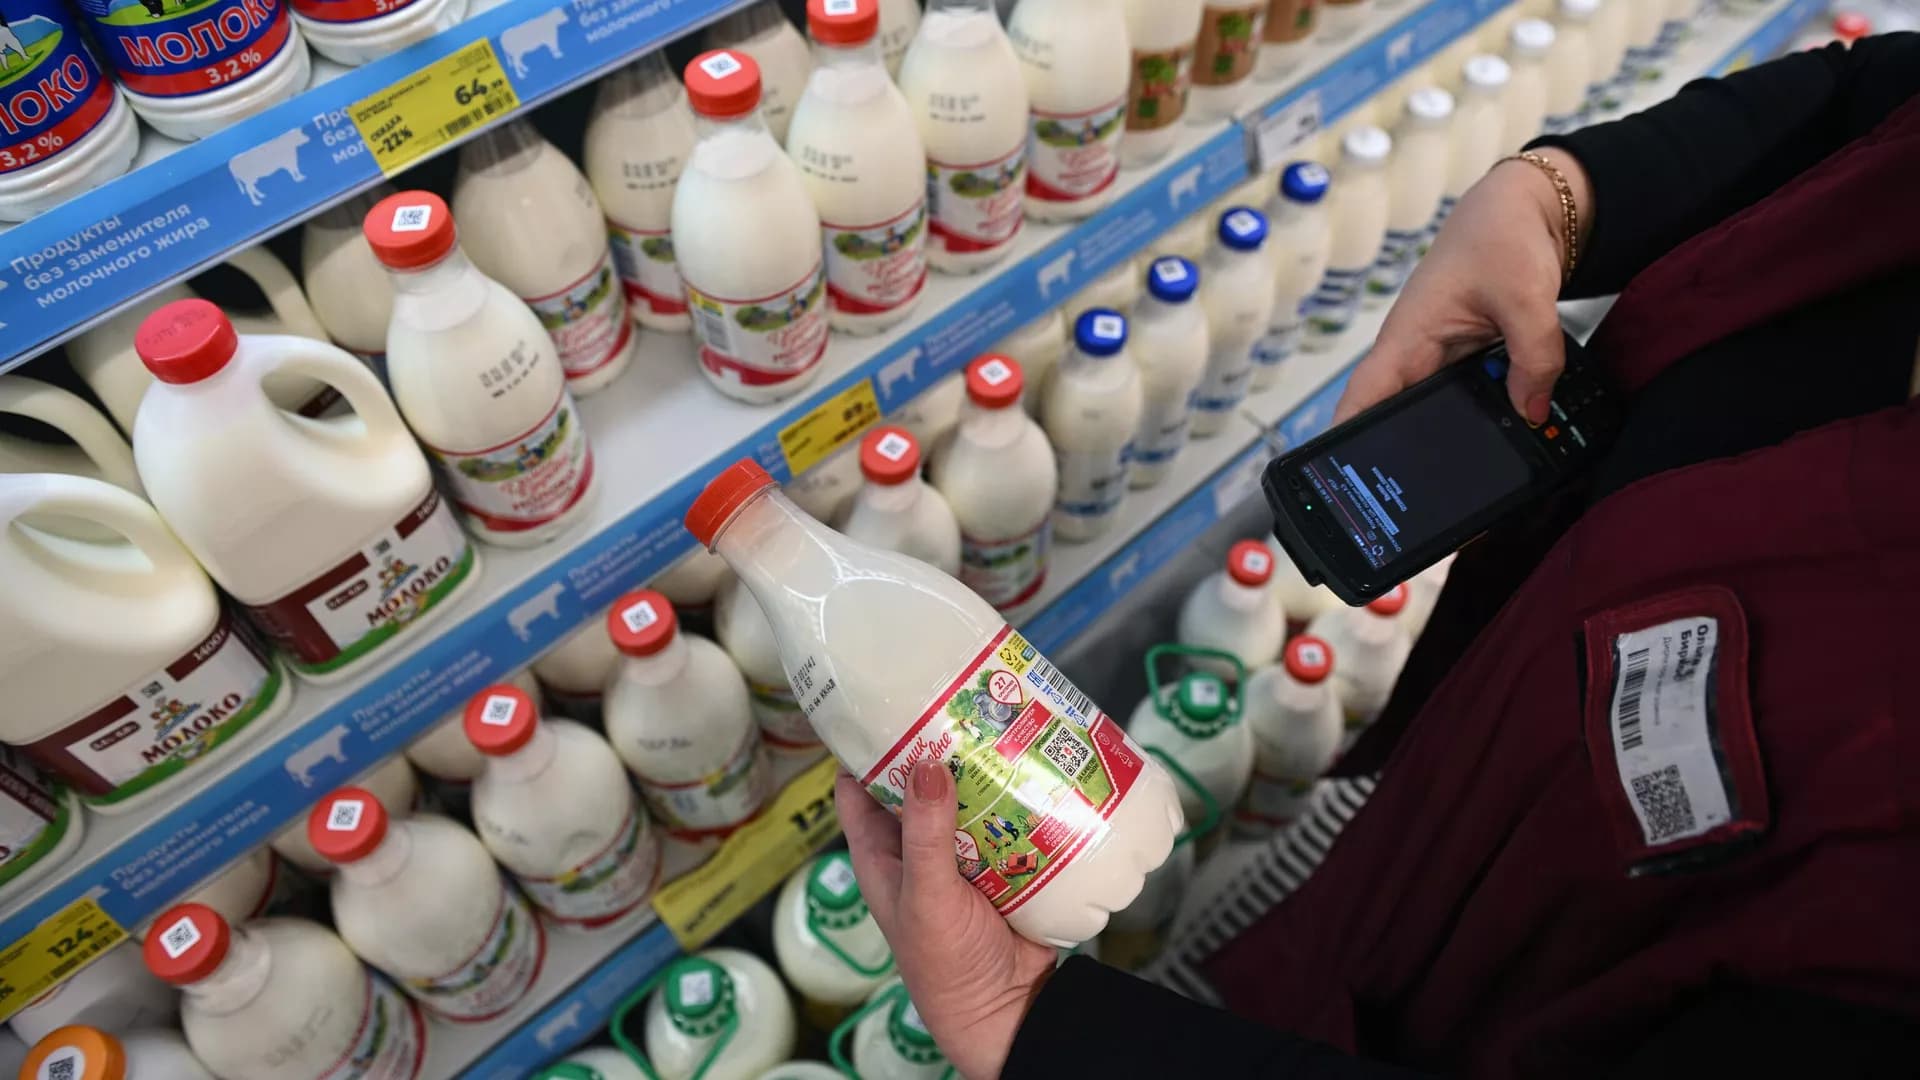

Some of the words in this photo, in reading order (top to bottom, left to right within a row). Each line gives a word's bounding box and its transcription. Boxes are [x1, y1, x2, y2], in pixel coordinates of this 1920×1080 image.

[205, 51, 262, 84] 3,2%
[455, 78, 488, 106] 64
[1, 132, 63, 167] 3,2%
[10, 215, 123, 274] Продукты
[24, 265, 65, 291] без
[66, 204, 191, 271] заменителя
[36, 247, 151, 309] молочного
[153, 217, 210, 251] жира
[366, 555, 450, 627] МОЛОКО
[994, 676, 1006, 690] 27
[141, 693, 242, 764] МОЛОКО
[927, 731, 952, 761] евне
[888, 736, 928, 790] Домик
[47, 927, 94, 958] 124
